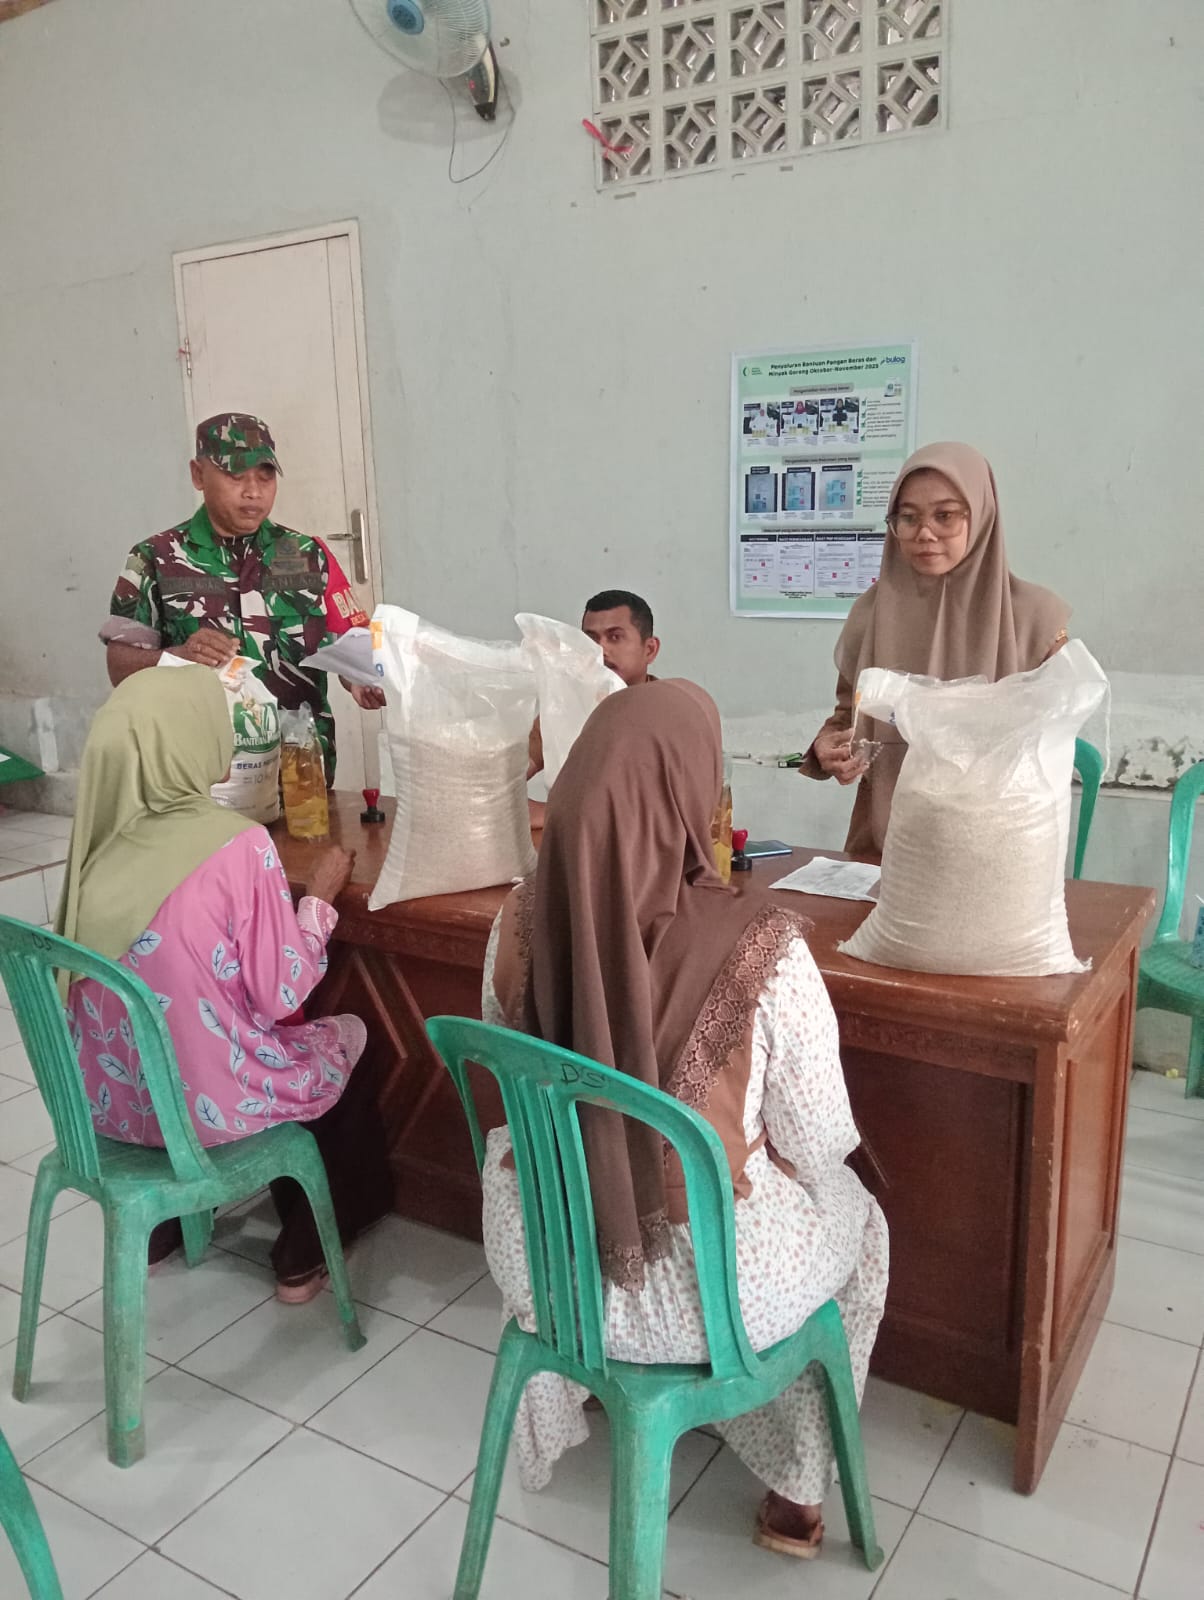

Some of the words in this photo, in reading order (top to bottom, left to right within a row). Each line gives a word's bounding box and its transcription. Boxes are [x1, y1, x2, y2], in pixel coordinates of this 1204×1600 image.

[802, 360, 825, 368] Bantuan
[826, 358, 848, 367] Pangan
[886, 355, 906, 365] bulog
[788, 368, 809, 376] Goreng
[560, 1063, 606, 1089] DS
